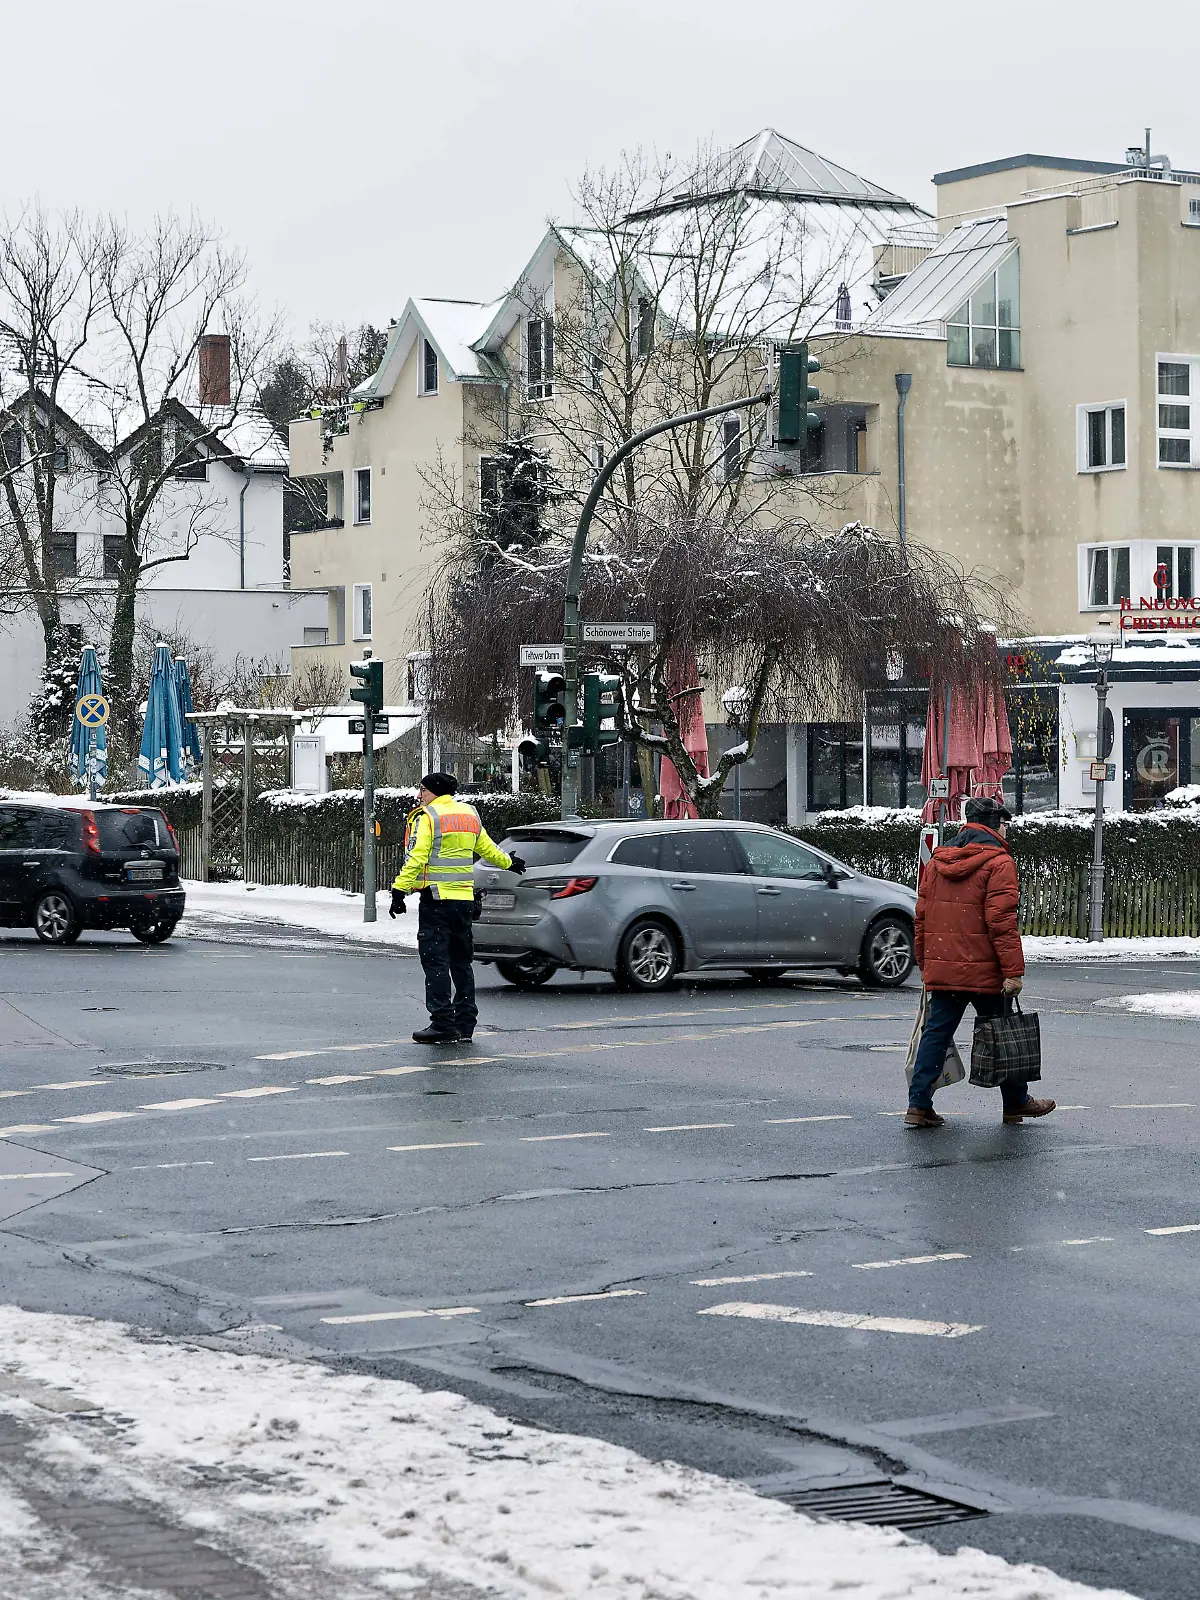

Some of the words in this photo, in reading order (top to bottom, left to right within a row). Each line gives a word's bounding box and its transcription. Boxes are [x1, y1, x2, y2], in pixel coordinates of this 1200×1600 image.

[585, 626, 626, 638] Schönower
[627, 626, 651, 640] Straße
[524, 649, 544, 661] Teltower
[544, 649, 560, 661] Damm
